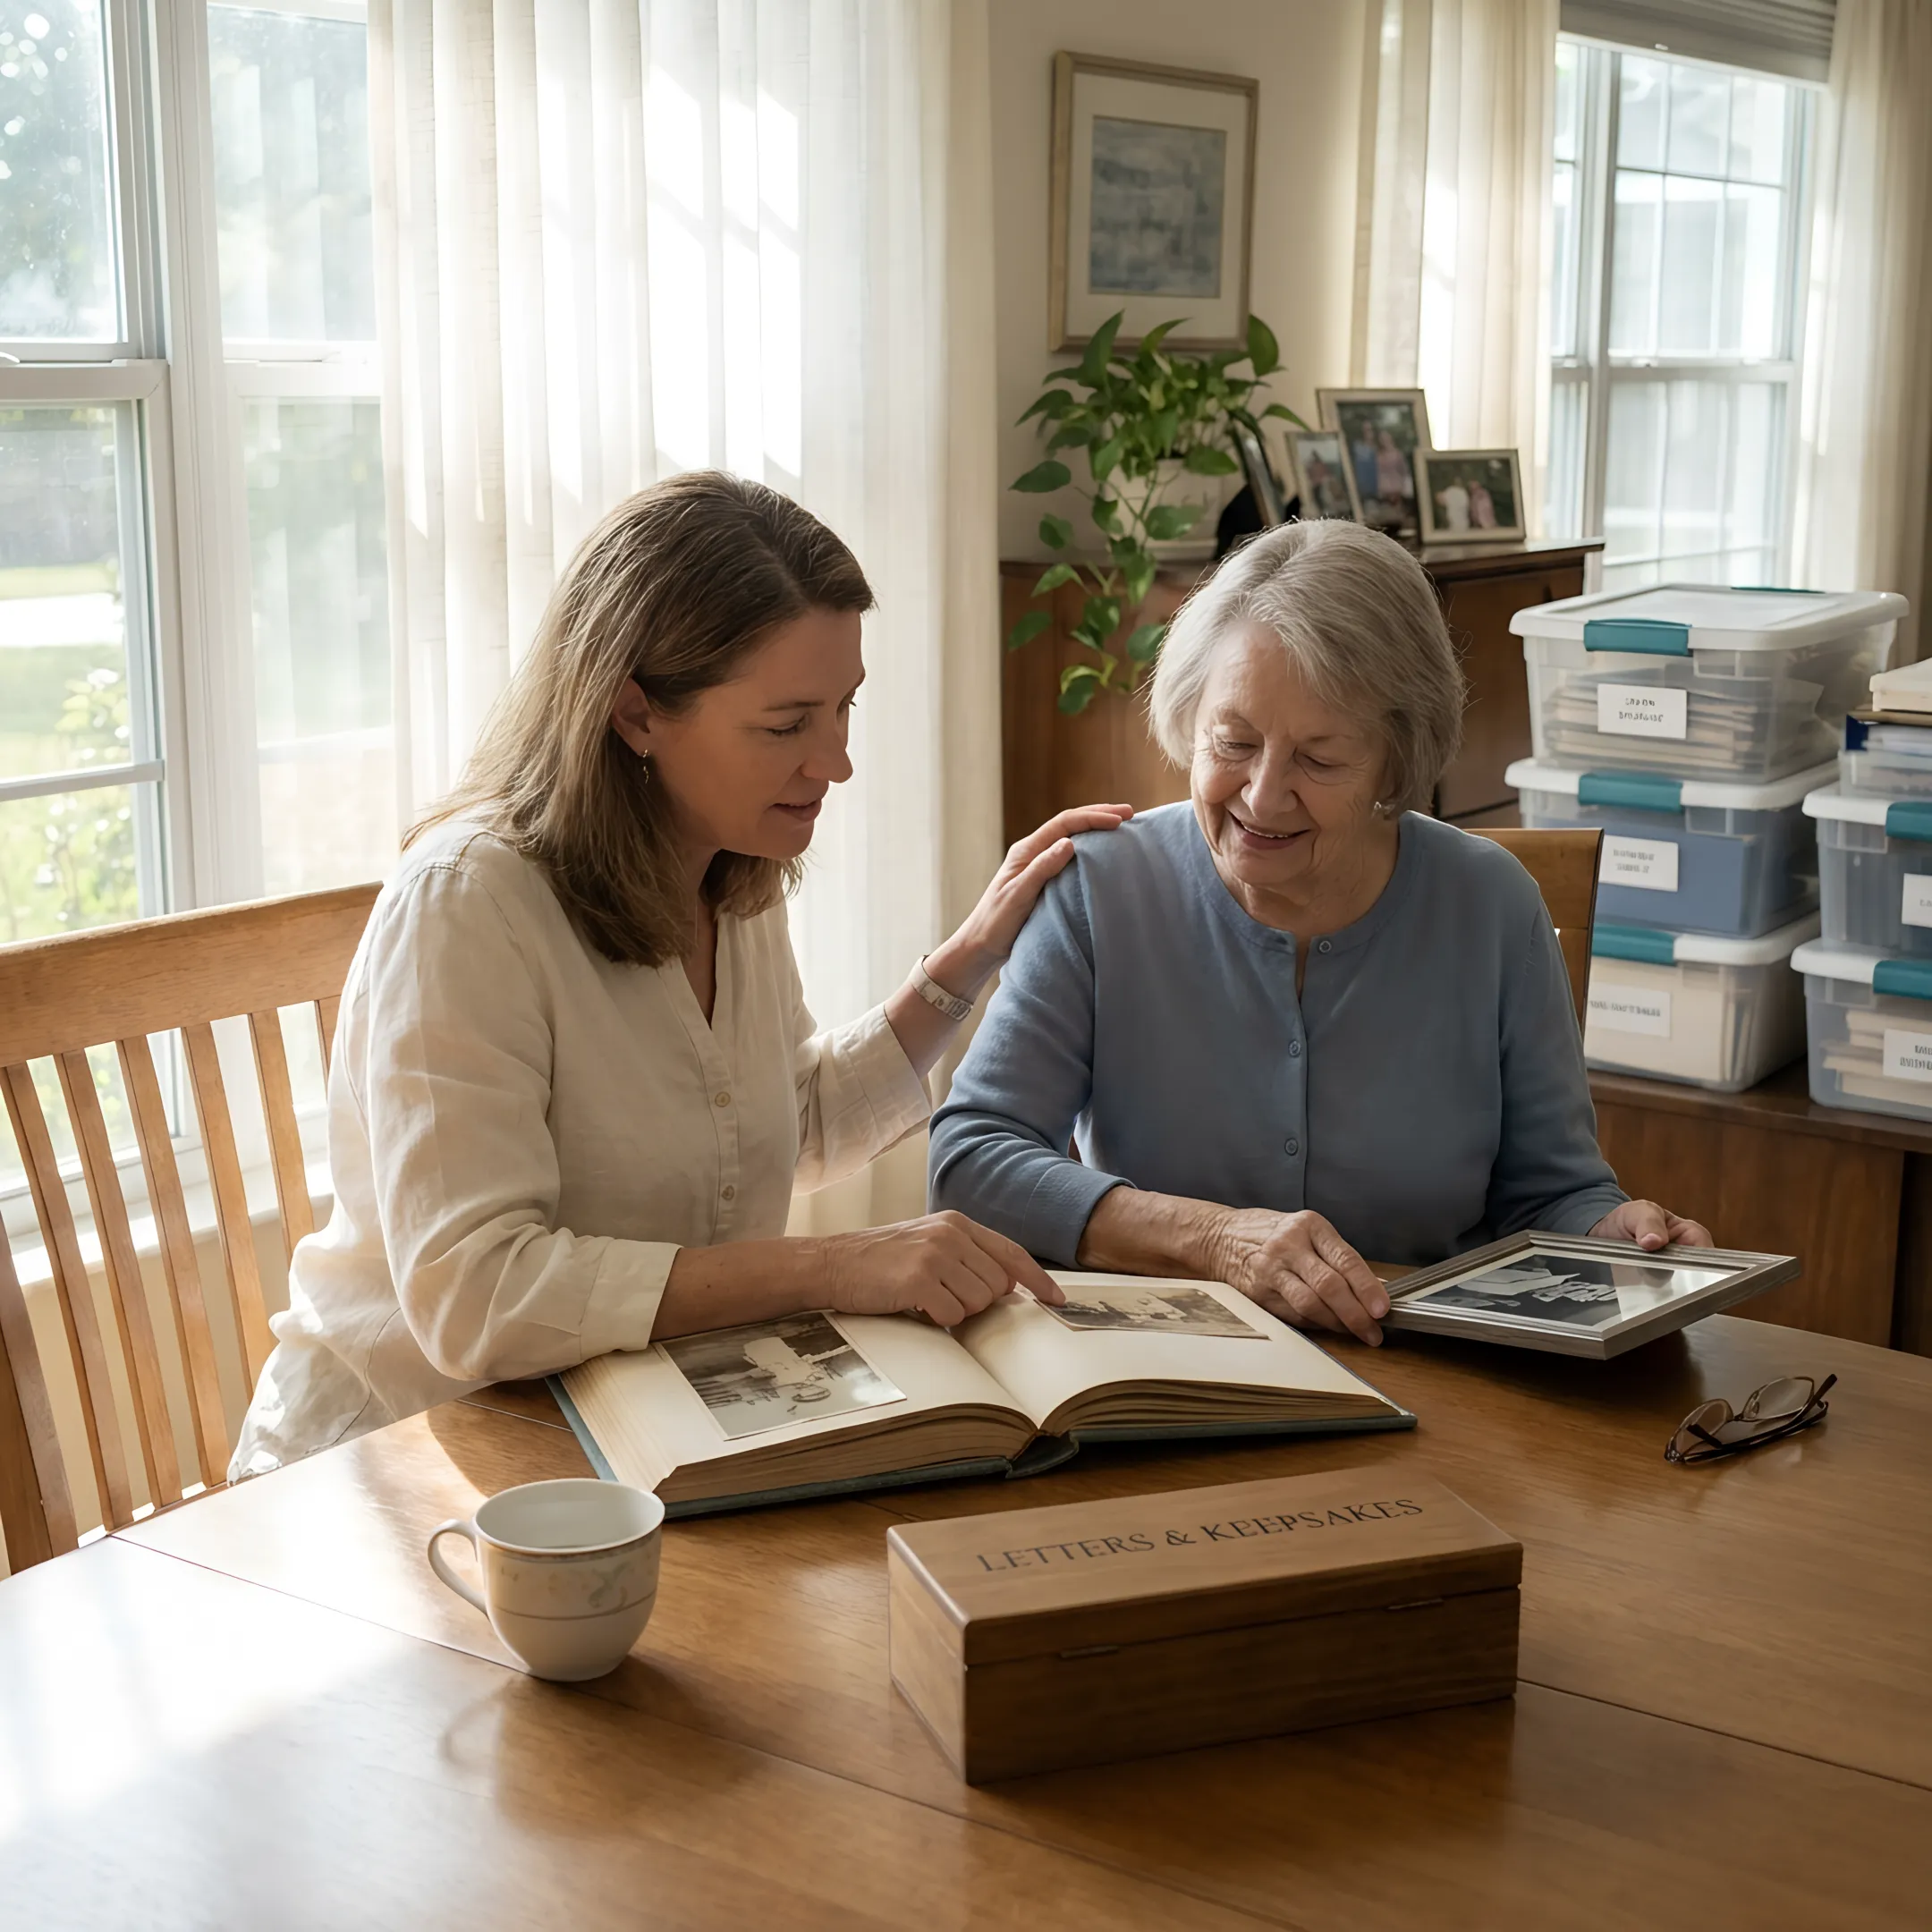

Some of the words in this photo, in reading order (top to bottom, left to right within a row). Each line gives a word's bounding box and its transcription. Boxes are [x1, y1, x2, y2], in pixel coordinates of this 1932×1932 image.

[977, 1533, 1155, 1572] LETTERS
[1165, 1530, 1198, 1546] &
[1199, 1499, 1423, 1541] KEEPSAKES
